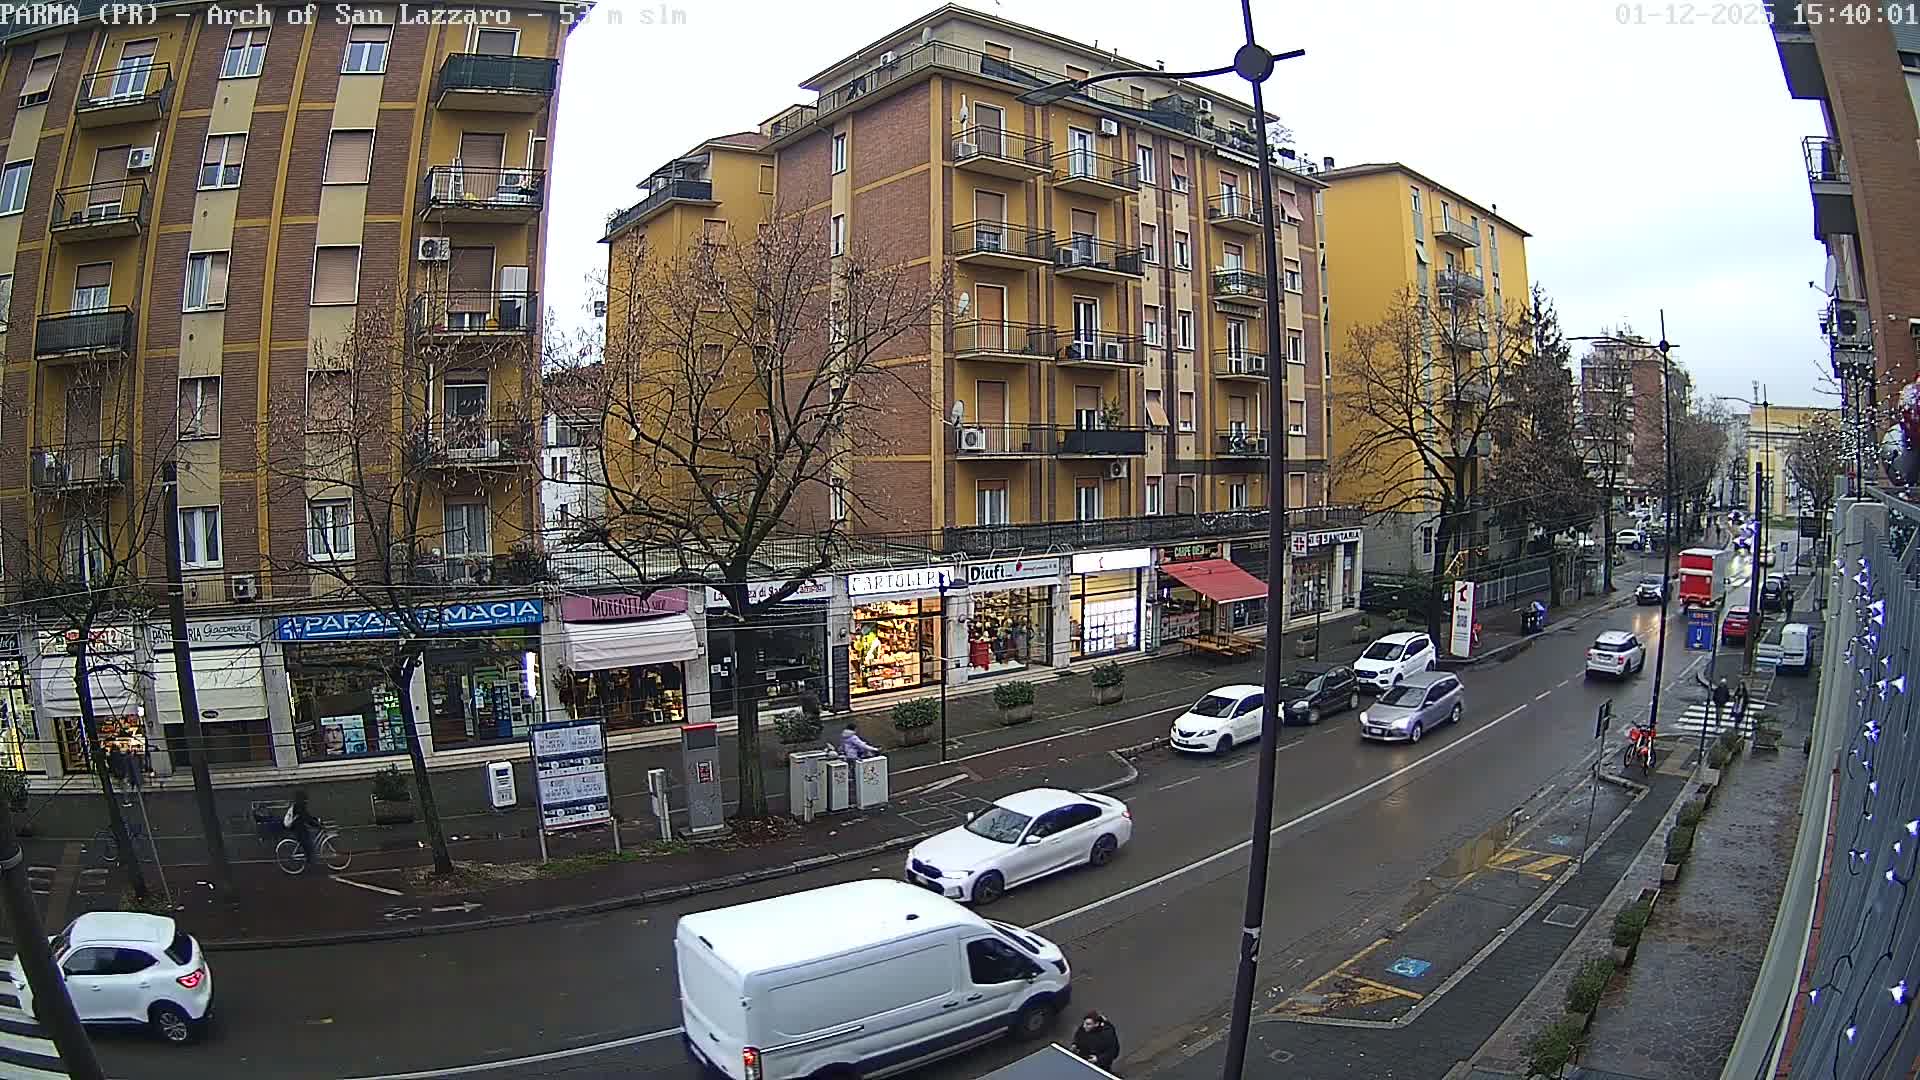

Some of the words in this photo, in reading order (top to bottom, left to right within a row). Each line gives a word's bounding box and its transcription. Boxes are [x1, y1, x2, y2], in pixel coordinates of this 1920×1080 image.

[852, 569, 952, 592] CARTOLERA
[305, 601, 539, 630] PARAFRMACIA
[591, 597, 651, 617] MORENITAS
